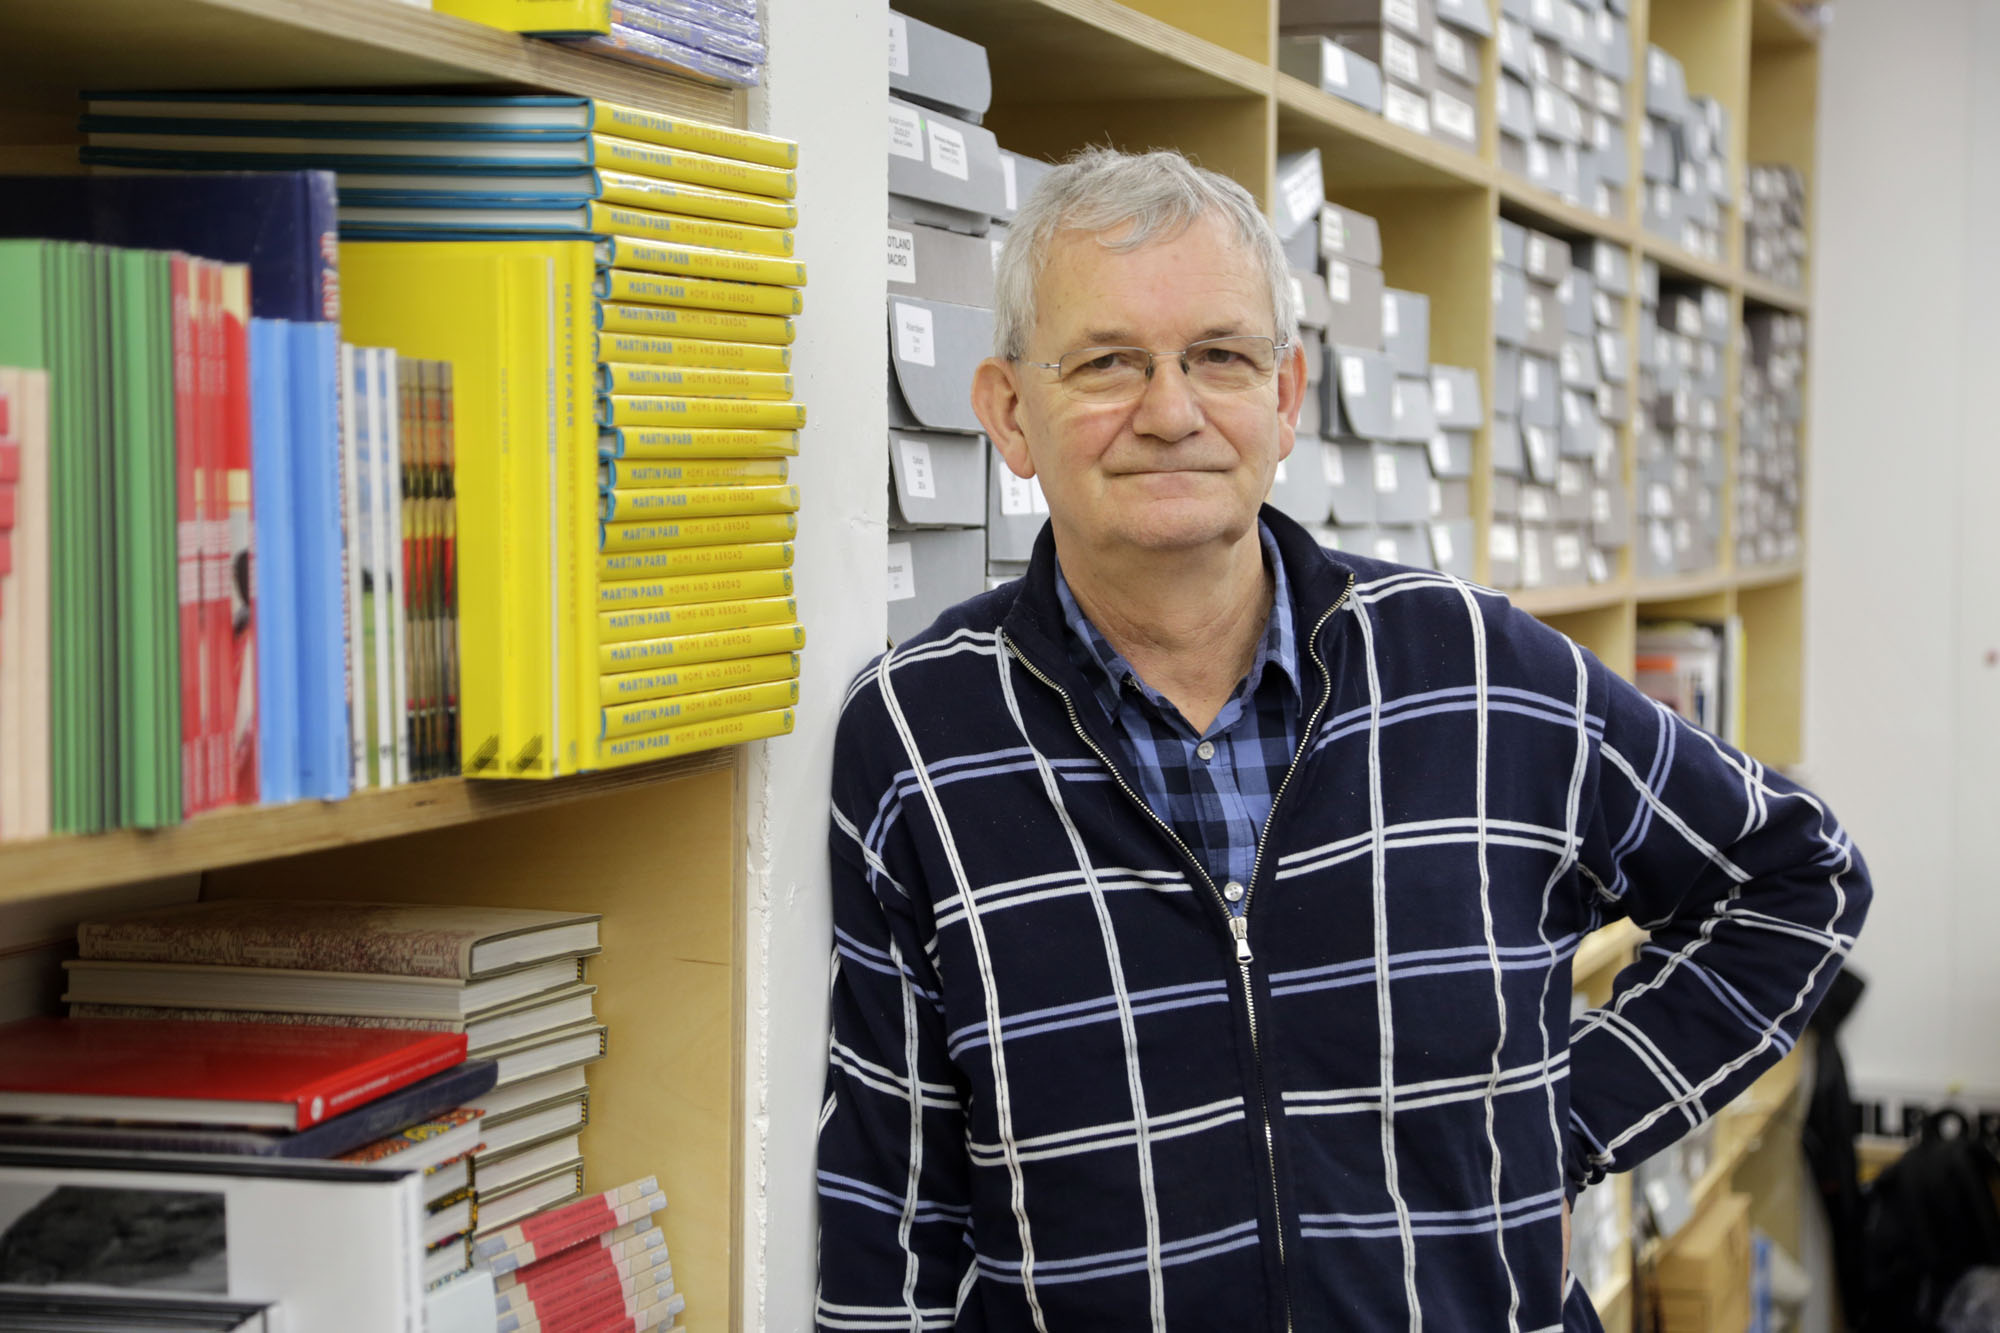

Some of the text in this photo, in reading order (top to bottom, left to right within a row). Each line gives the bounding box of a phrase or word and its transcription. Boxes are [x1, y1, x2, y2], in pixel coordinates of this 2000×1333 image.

[611, 211, 647, 227] MARTIN
[649, 217, 670, 231] PARR
[633, 248, 666, 262] MARTIN
[668, 252, 689, 265] PARR
[628, 282, 662, 296] MARTIN
[664, 285, 685, 298] PARR
[620, 308, 654, 321] MARTIN
[655, 311, 677, 323] PARR
[616, 340, 650, 352] MARTIN
[651, 342, 673, 353] PARR
[628, 371, 660, 382] MARTIN
[661, 372, 683, 384] PARR
[630, 402, 663, 412] MARTIN
[664, 402, 686, 412] PARR
[640, 434, 670, 444] MARTIN
[671, 434, 692, 444] PARR
[632, 468, 660, 479] MARTIN
[662, 468, 682, 478] PARR
[632, 496, 665, 508] MARTIN
[666, 495, 687, 506] PARR
[622, 528, 655, 540] MARTIN
[657, 526, 679, 538] PARR
[607, 557, 642, 568] MARTIN
[644, 555, 666, 567] PARR
[602, 588, 638, 600] MARTIN
[640, 586, 663, 598] PARR
[610, 614, 646, 628] MARTIN
[648, 612, 670, 625] PARR
[611, 646, 648, 660] MARTIN
[650, 643, 673, 656] PARR
[619, 677, 652, 692] MARTIN
[654, 674, 678, 687] PARR
[623, 708, 657, 725] MARTIN
[659, 704, 680, 719] PARR
[611, 739, 645, 755] MARTIN
[647, 735, 670, 749] PARR
